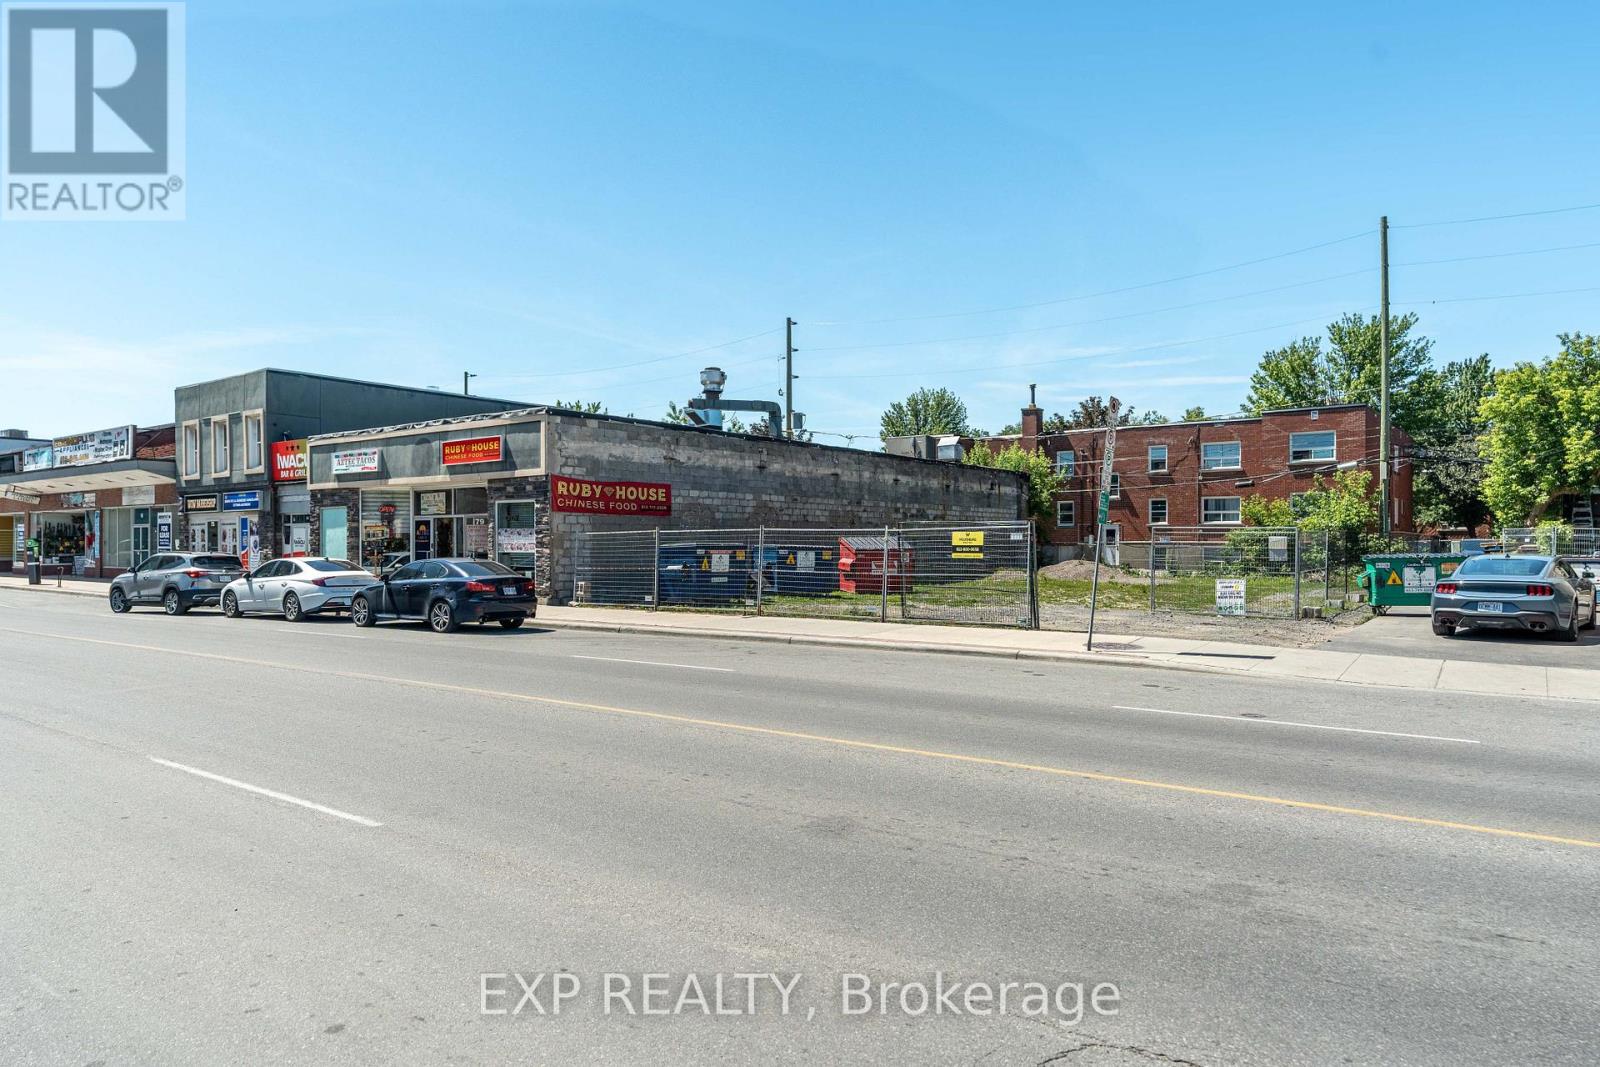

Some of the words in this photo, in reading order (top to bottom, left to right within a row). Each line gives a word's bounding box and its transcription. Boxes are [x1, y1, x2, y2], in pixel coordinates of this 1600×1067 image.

[445, 444, 466, 454] RUBY
[471, 440, 499, 452] HOUSE
[336, 458, 356, 466] AZTEC
[356, 456, 376, 465] TACOS
[280, 470, 290, 478] BAR
[557, 480, 602, 498] RUBY
[615, 485, 667, 501] HOUSE
[377, 504, 395, 513] OPEN
[557, 498, 606, 509] CHINESE
[609, 501, 638, 511] FOOD
